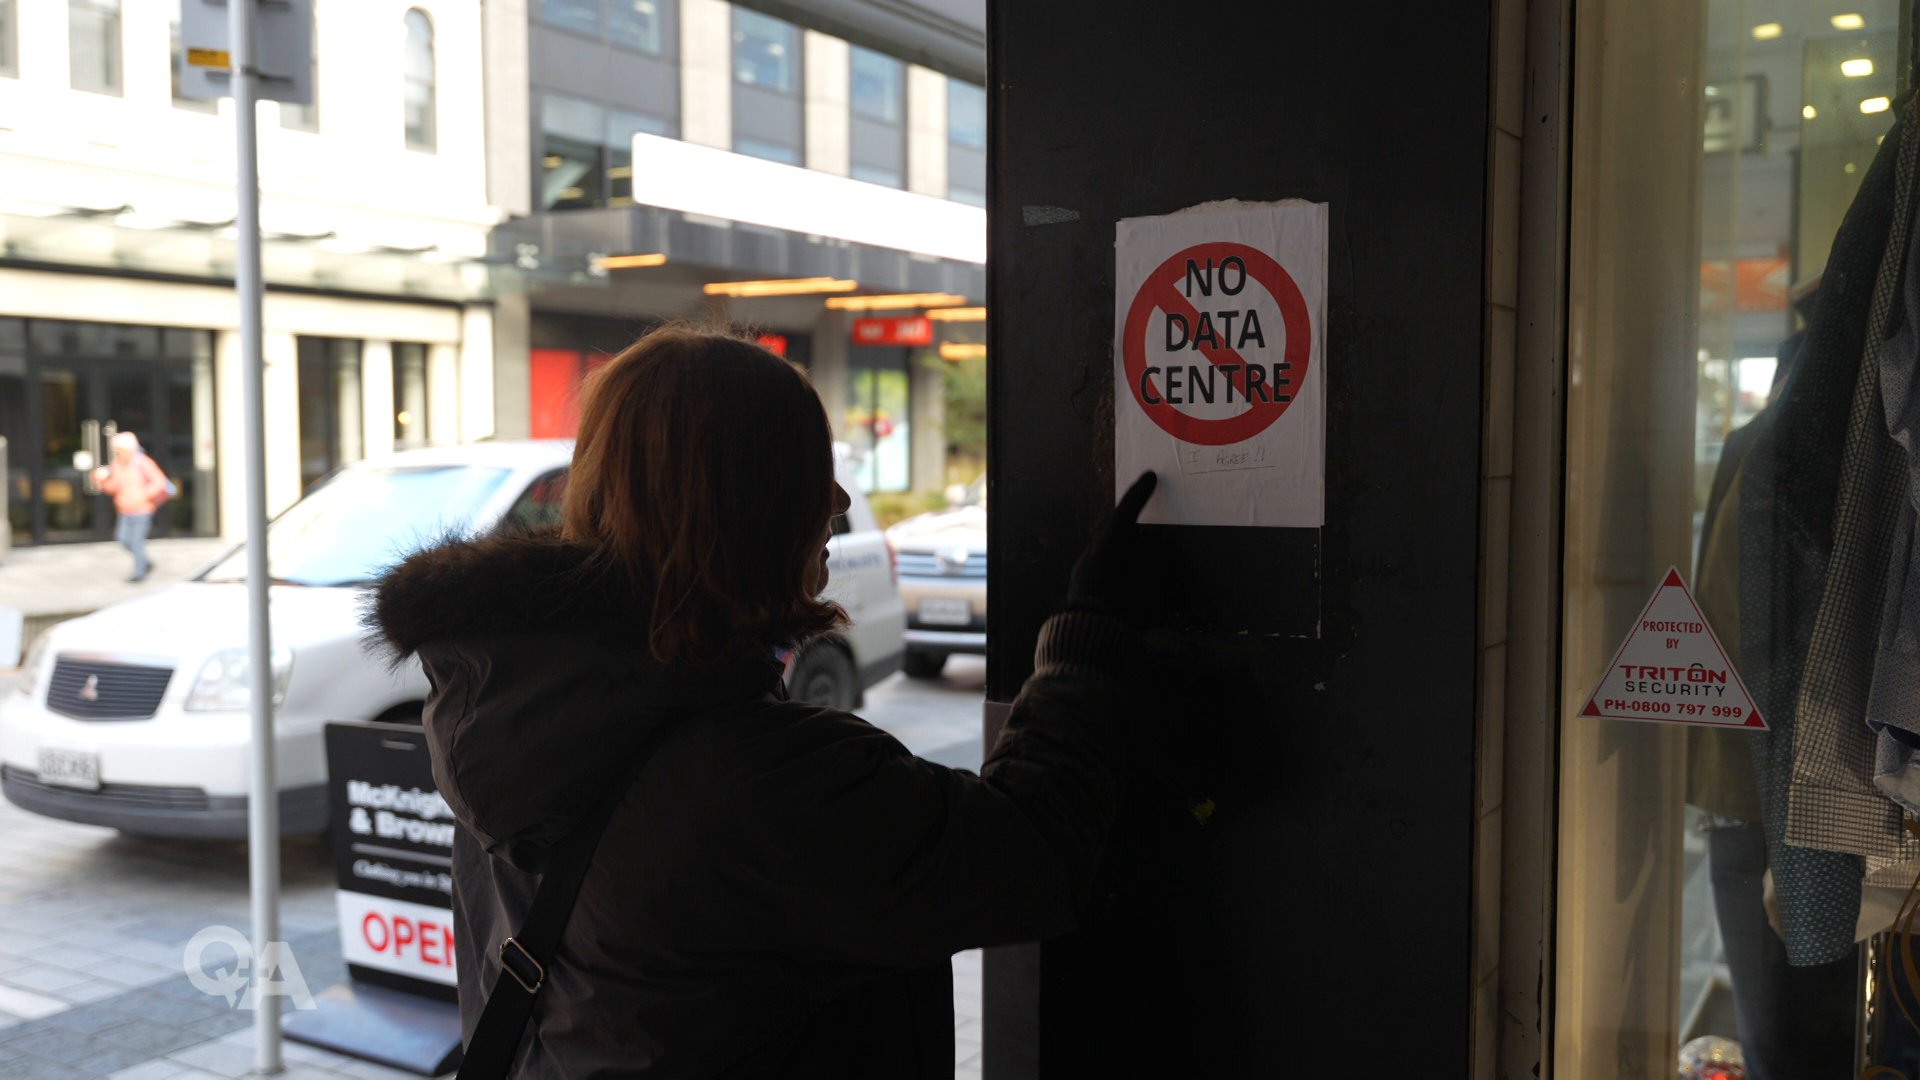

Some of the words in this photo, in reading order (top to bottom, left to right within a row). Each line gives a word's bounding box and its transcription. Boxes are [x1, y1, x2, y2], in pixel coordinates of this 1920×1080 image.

[1185, 255, 1247, 298] NO
[1165, 308, 1266, 351] DATA
[1140, 362, 1292, 405] CENTRE
[1642, 620, 1703, 634] PROTECTED
[1666, 638, 1680, 650] BY
[1619, 663, 1727, 685] TRITON
[1625, 681, 1726, 698] SECURITY
[1604, 699, 1671, 714] PH-0800
[1676, 703, 1707, 716] 797
[1711, 706, 1743, 718] 999
[347, 779, 457, 820] McKnigh
[349, 807, 373, 836] &
